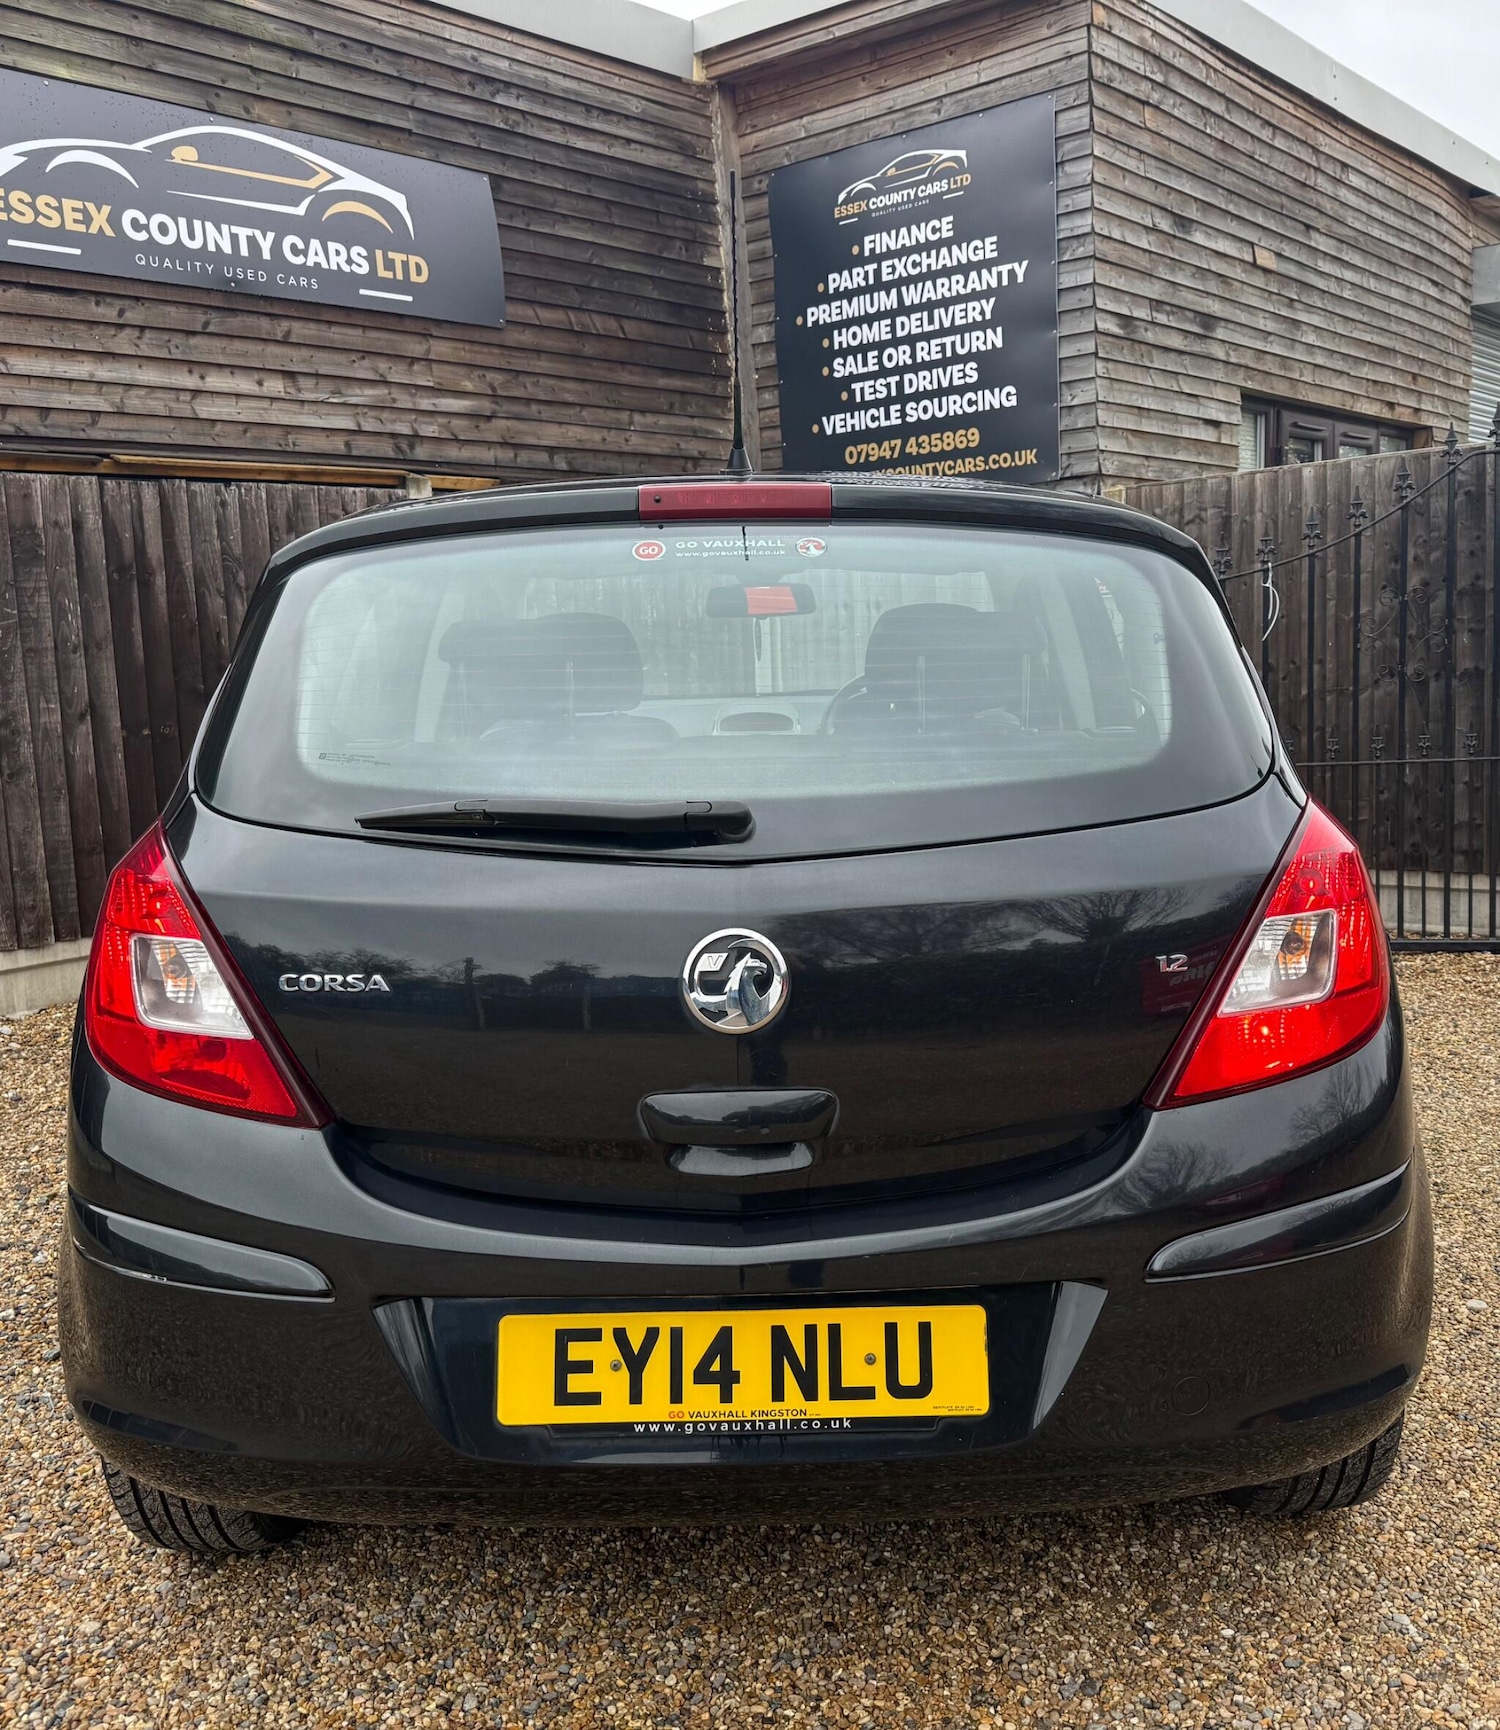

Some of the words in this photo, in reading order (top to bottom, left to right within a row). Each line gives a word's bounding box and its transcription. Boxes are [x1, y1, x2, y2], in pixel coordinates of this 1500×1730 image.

[834, 200, 868, 218] ESSEX
[869, 187, 917, 209] COUNTY
[917, 179, 948, 196] CARS
[950, 173, 972, 188] LTD
[871, 208, 896, 217] QUALITY
[897, 203, 913, 211] USED
[914, 199, 930, 207] CARS
[121, 208, 276, 260] COUNTY
[282, 234, 370, 275] CARS
[375, 248, 430, 284] LTD
[863, 216, 954, 257] FINANCE
[135, 253, 214, 275] QUALITY
[224, 265, 267, 282] USED
[276, 273, 319, 289] CARS
[827, 263, 878, 295] PART
[881, 235, 998, 283] EXCHANGE
[806, 287, 898, 328] PREMIUM
[900, 260, 1029, 307] WARRANTY
[833, 318, 892, 350] HOME
[895, 297, 995, 338] DELIVERY
[833, 350, 879, 378] SALE
[882, 344, 913, 369] OR
[916, 326, 1003, 363] RETURN
[851, 375, 900, 403] TEST
[903, 361, 979, 395] DRIVES
[822, 404, 902, 436] VEHICLE
[905, 385, 1018, 423] SOURCING
[844, 439, 902, 465] 07947
[905, 427, 980, 456] 435869
[639, 545, 659, 555] GO
[675, 541, 698, 549] GO
[702, 539, 786, 549] VAUXHALL
[675, 549, 786, 558] www.govauxhall.co.uk
[278, 973, 391, 993] CORSA
[553, 1325, 741, 1407] EY14
[770, 1321, 934, 1403] NLU
[633, 1417, 852, 1435] www.govauxhall.co.uk
[668, 1410, 685, 1419] GO
[688, 1409, 748, 1419] VAUXHALL
[750, 1408, 808, 1418] KINGSTON
